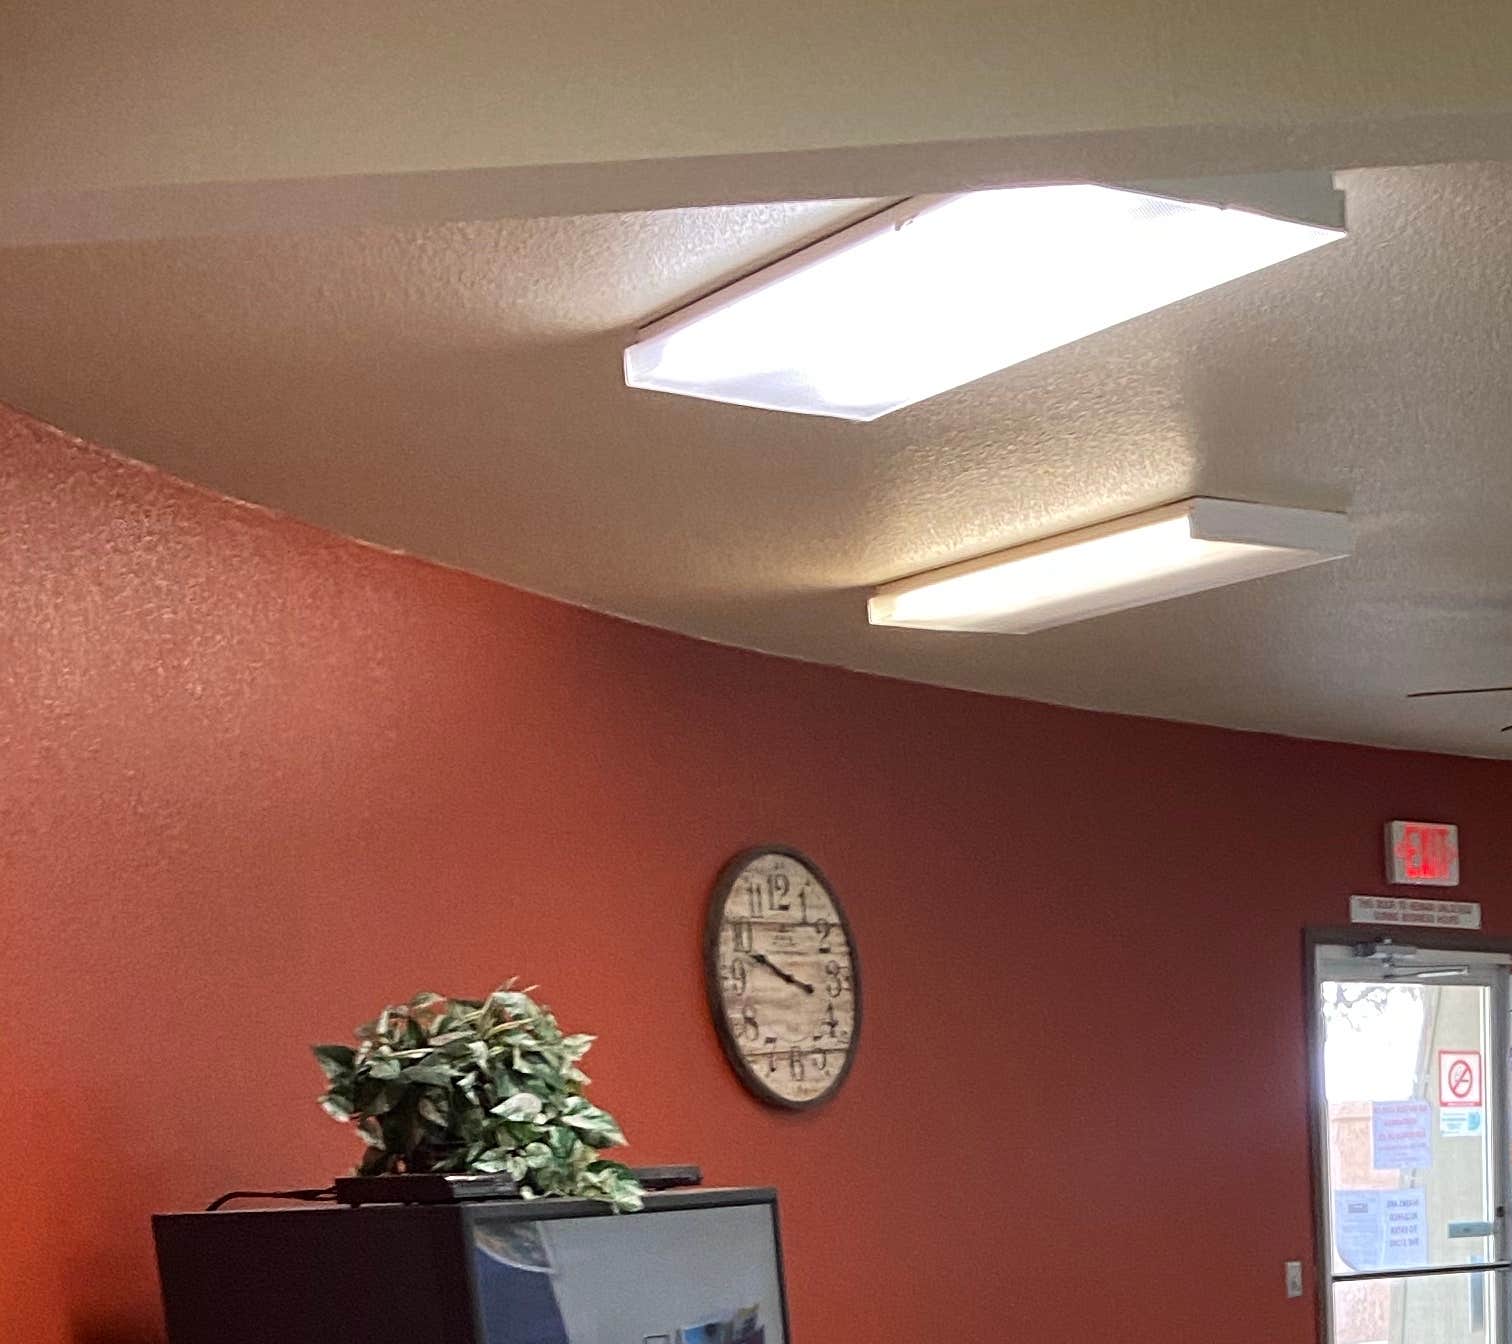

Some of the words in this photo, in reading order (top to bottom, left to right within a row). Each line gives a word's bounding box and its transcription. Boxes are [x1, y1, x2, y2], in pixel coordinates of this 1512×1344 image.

[750, 882, 764, 919] 11
[768, 873, 790, 911] 12
[815, 918, 831, 953] 2
[732, 957, 746, 995] 9
[825, 959, 842, 998] 3
[743, 1003, 759, 1042] 8
[821, 1002, 839, 1039] 4
[764, 1036, 777, 1073] 7
[789, 1045, 804, 1082] 6
[812, 1034, 827, 1070] 5
